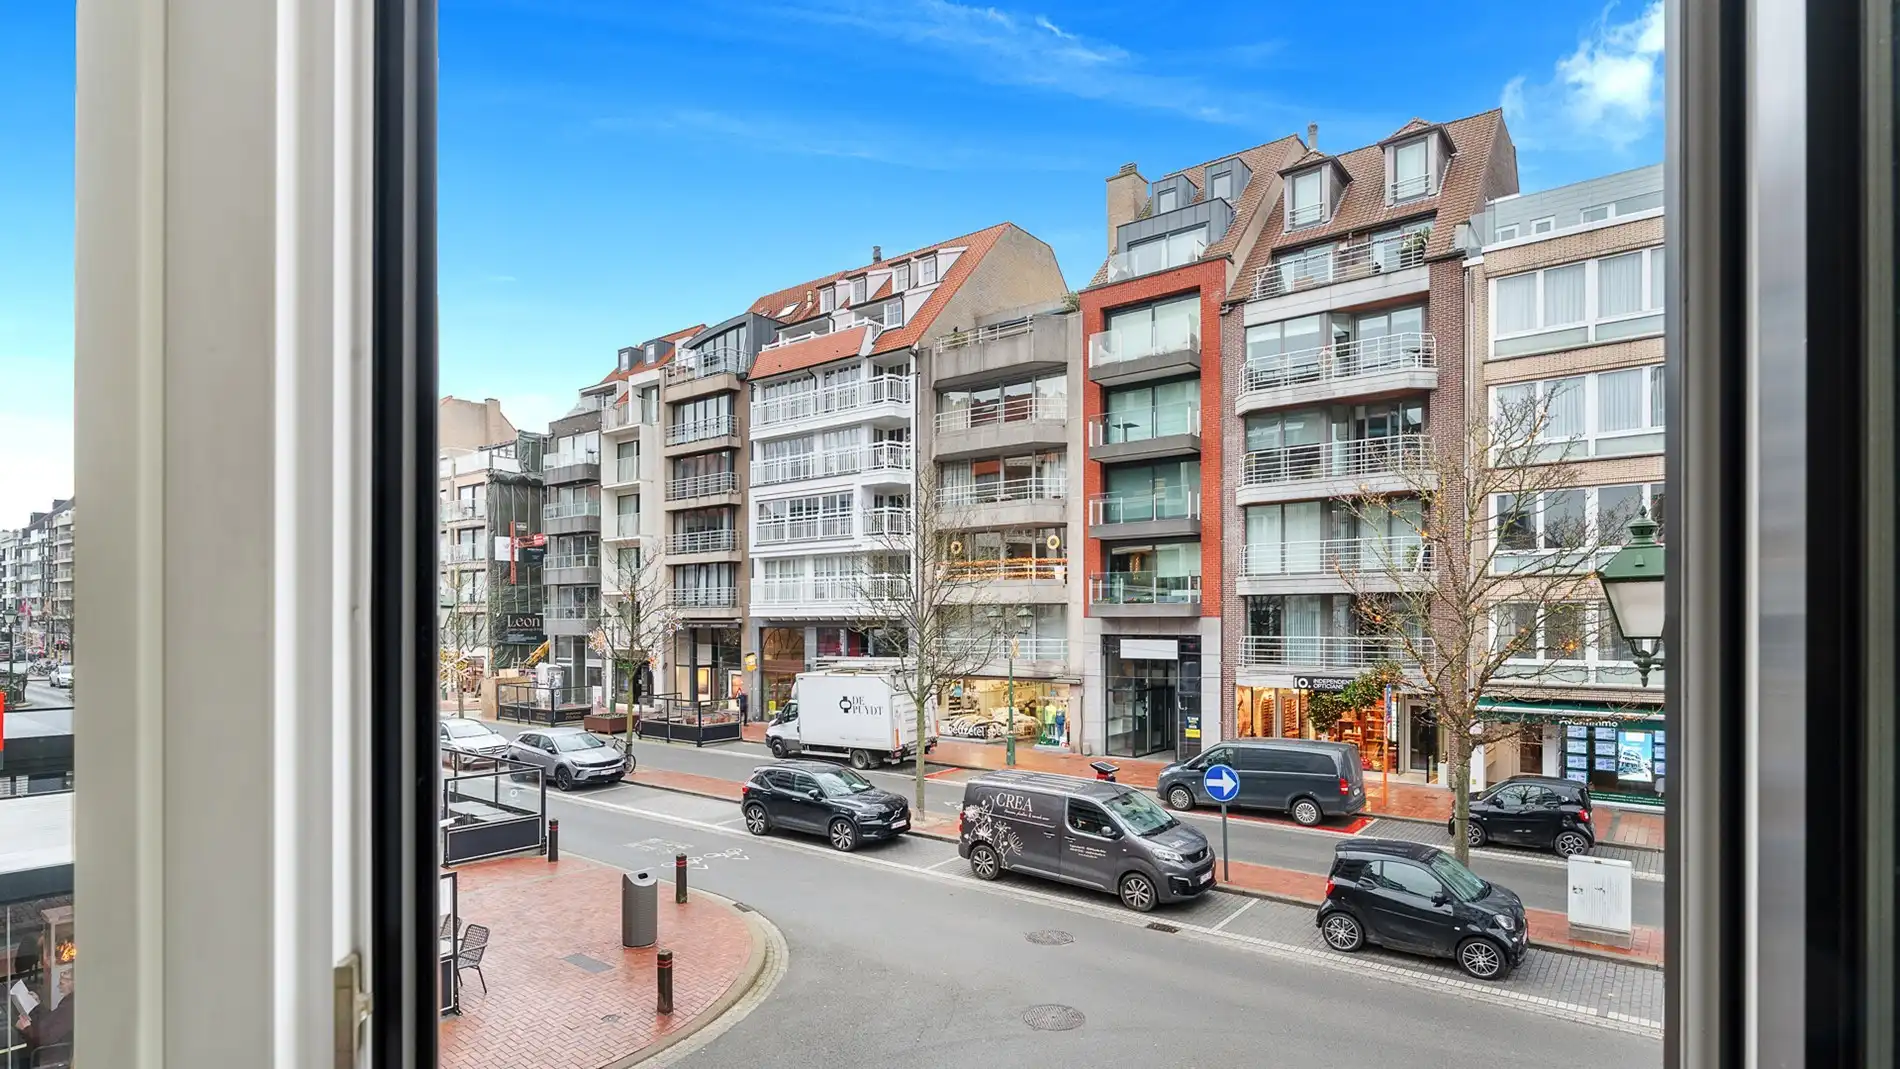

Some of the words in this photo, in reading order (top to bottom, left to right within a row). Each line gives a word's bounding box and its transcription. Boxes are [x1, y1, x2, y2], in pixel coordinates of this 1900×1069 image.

[507, 614, 540, 627] Leon
[852, 695, 865, 705] DE
[852, 705, 883, 715] PUYDT
[996, 792, 1032, 812] CREA
